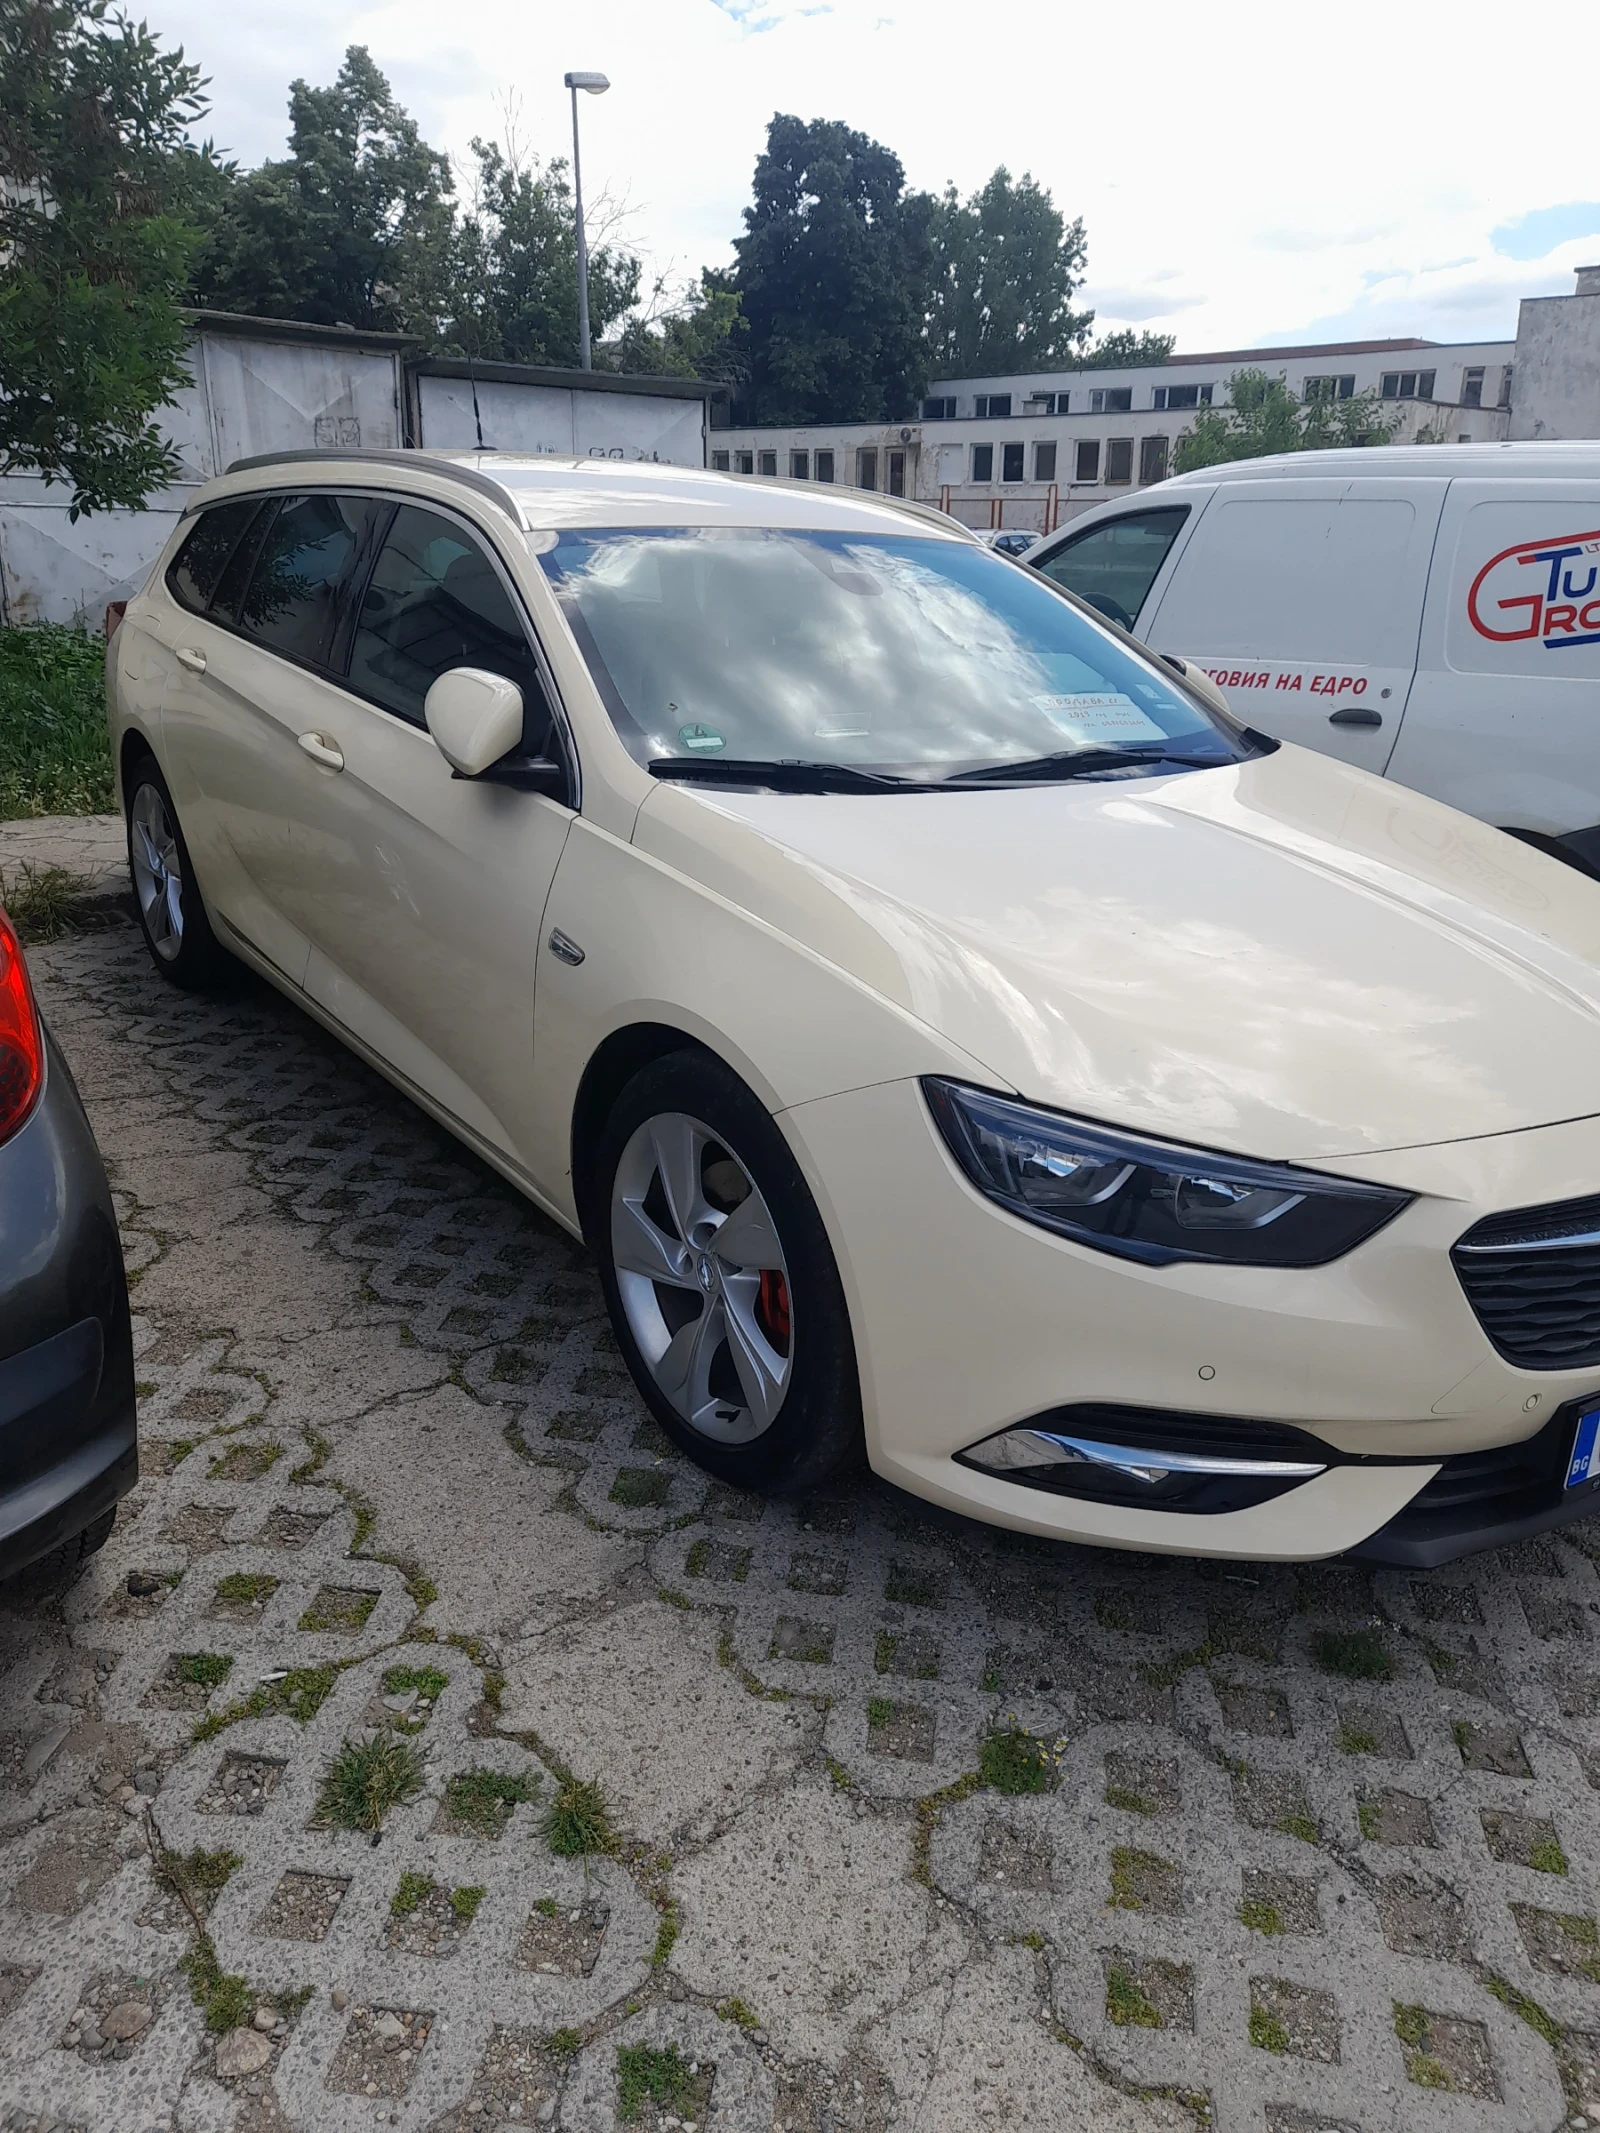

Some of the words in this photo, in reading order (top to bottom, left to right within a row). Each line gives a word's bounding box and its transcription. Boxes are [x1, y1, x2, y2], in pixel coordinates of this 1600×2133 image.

[1201, 668, 1270, 689] ГОВИЯ
[1275, 673, 1303, 691] НА
[1309, 675, 1368, 696] ЕДРО
[1571, 1454, 1589, 1475] BG
